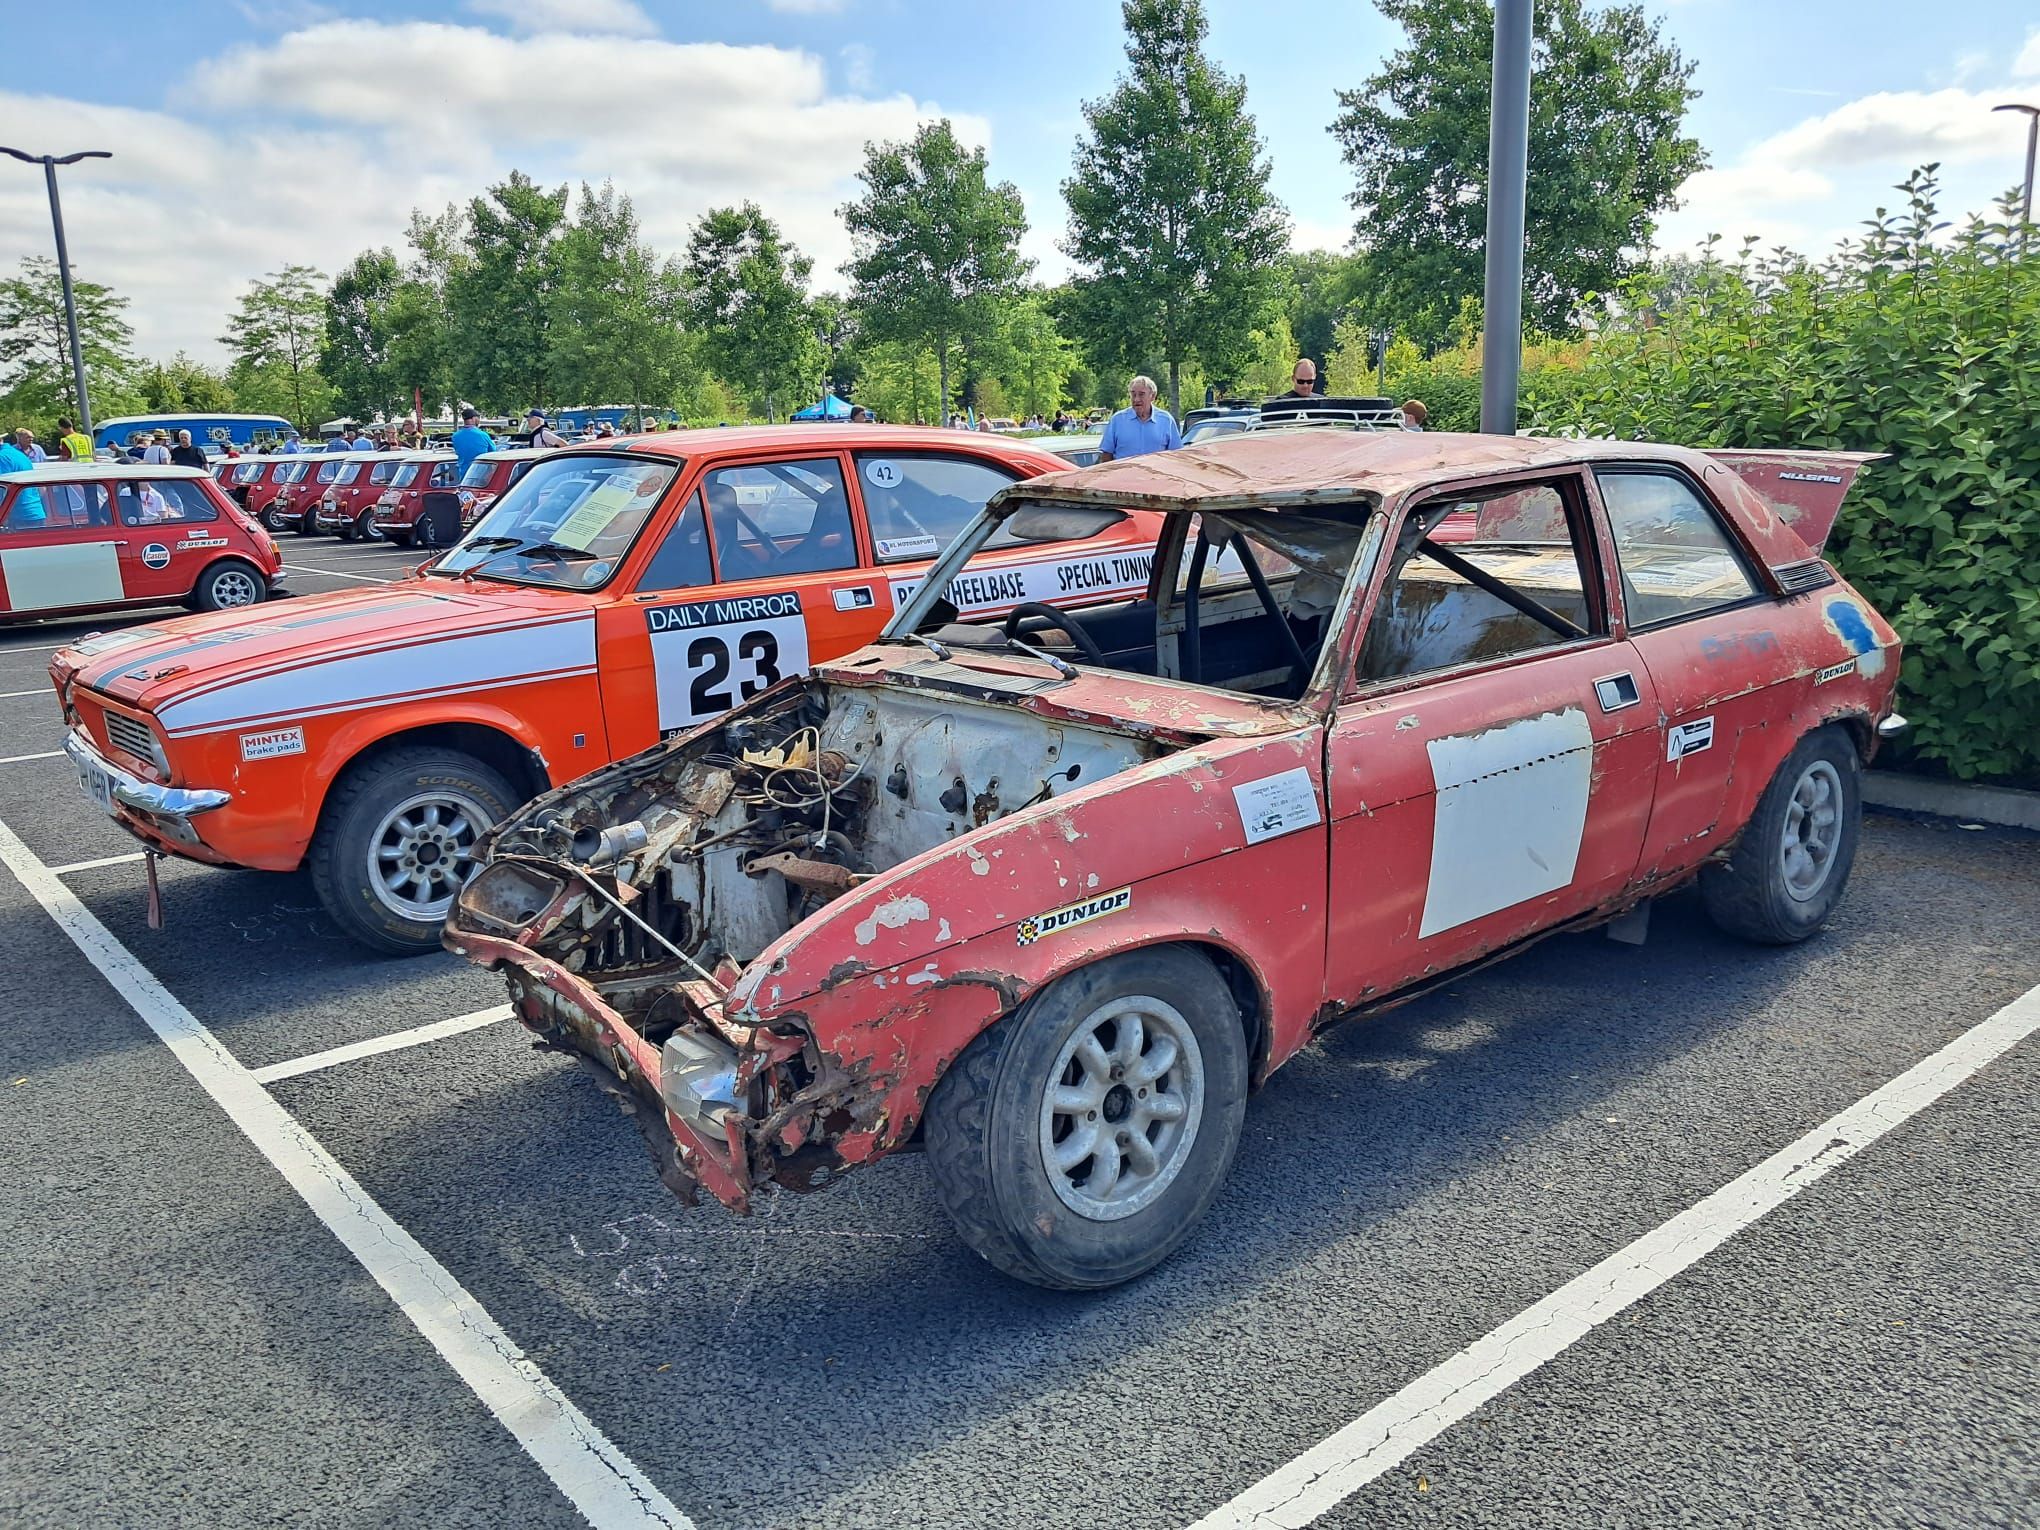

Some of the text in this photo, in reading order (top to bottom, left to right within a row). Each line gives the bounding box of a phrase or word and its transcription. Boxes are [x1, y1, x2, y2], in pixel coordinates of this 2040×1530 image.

[877, 467, 894, 480] 42
[1779, 472, 1842, 484] AUSTIN
[187, 539, 225, 547] DUNLOP
[146, 551, 168, 560] Castrol
[1057, 561, 1112, 591] SPECIAL
[1112, 554, 1155, 583] TUNIN
[649, 594, 800, 631] DAILY MIRROR
[687, 630, 781, 717] 23
[1823, 662, 1854, 680] DUNLOP
[245, 731, 299, 747] MINTEX
[246, 742, 301, 756] brake pads
[416, 776, 509, 817] SCORPION
[1042, 892, 1129, 931] DUNLOP
